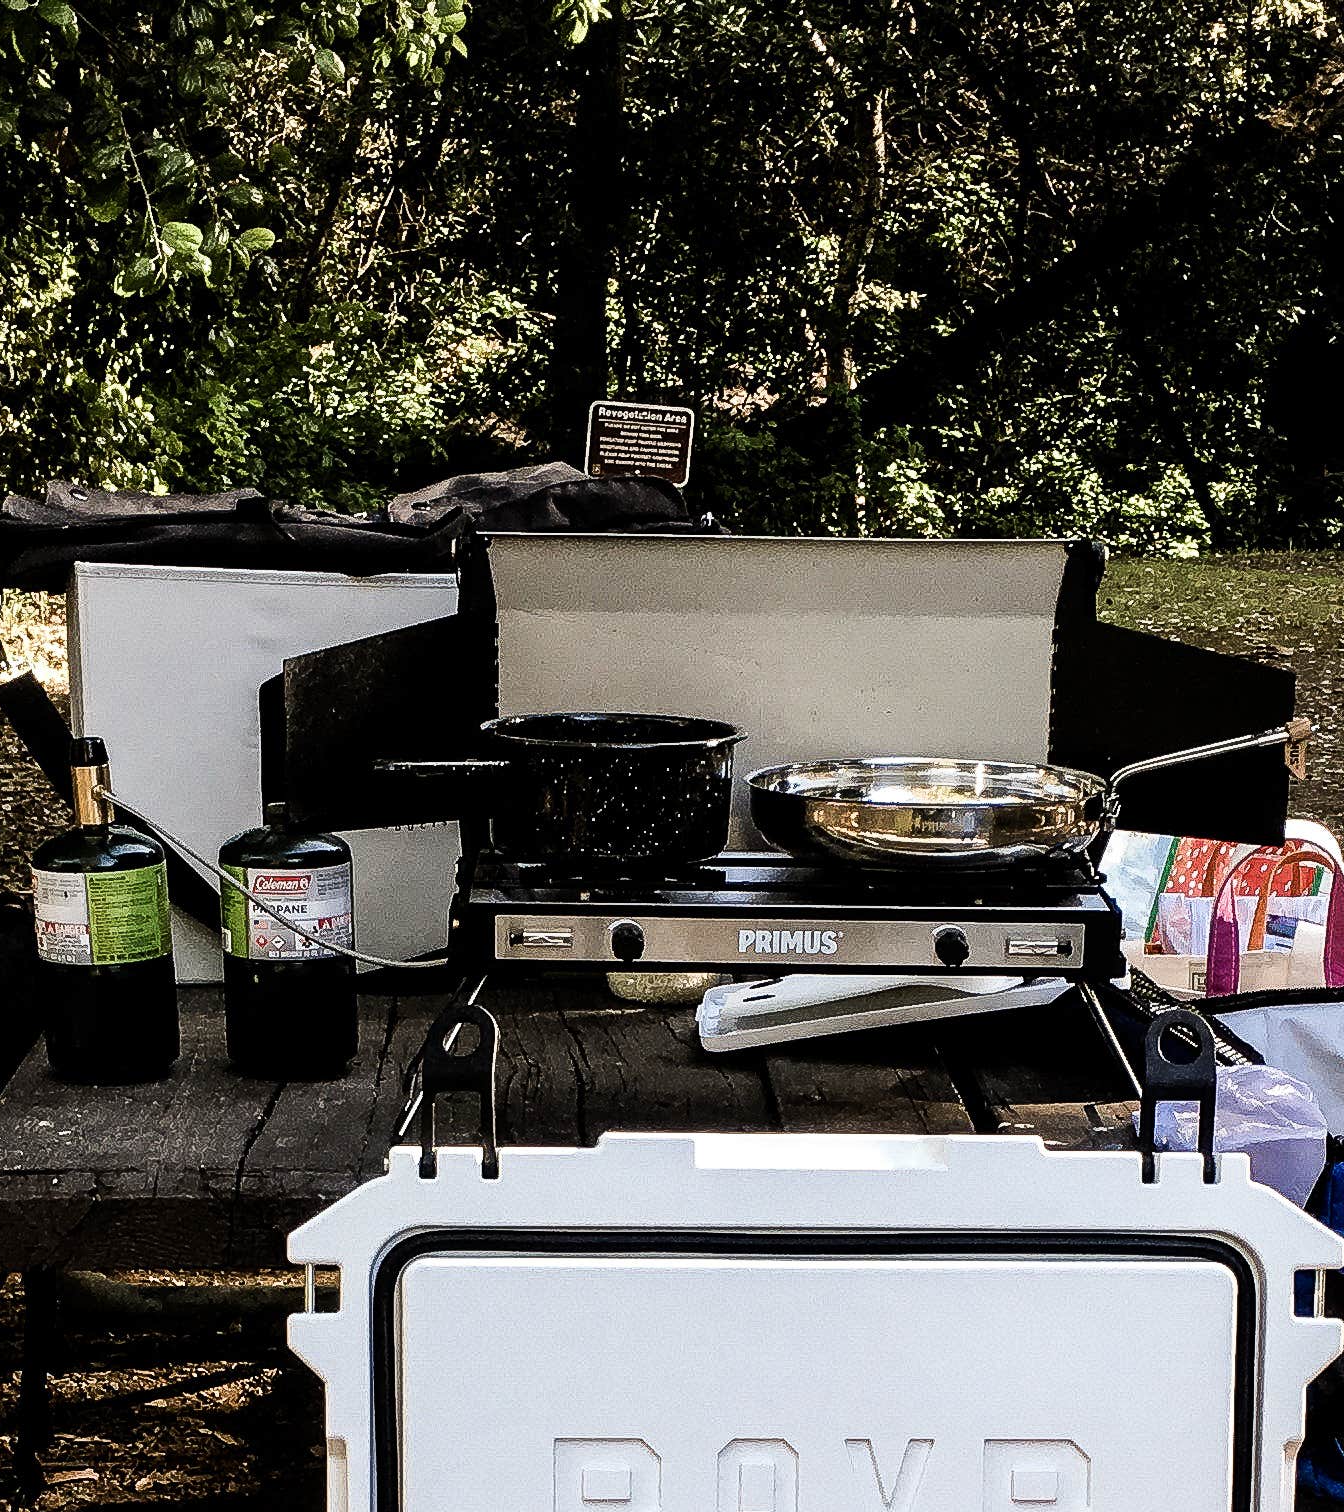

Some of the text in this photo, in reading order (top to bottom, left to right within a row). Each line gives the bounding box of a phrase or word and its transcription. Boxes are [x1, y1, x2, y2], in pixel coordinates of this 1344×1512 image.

[598, 407, 687, 423] Revegetation Area
[256, 876, 299, 891] Coleman
[738, 930, 838, 954] PRIMUS
